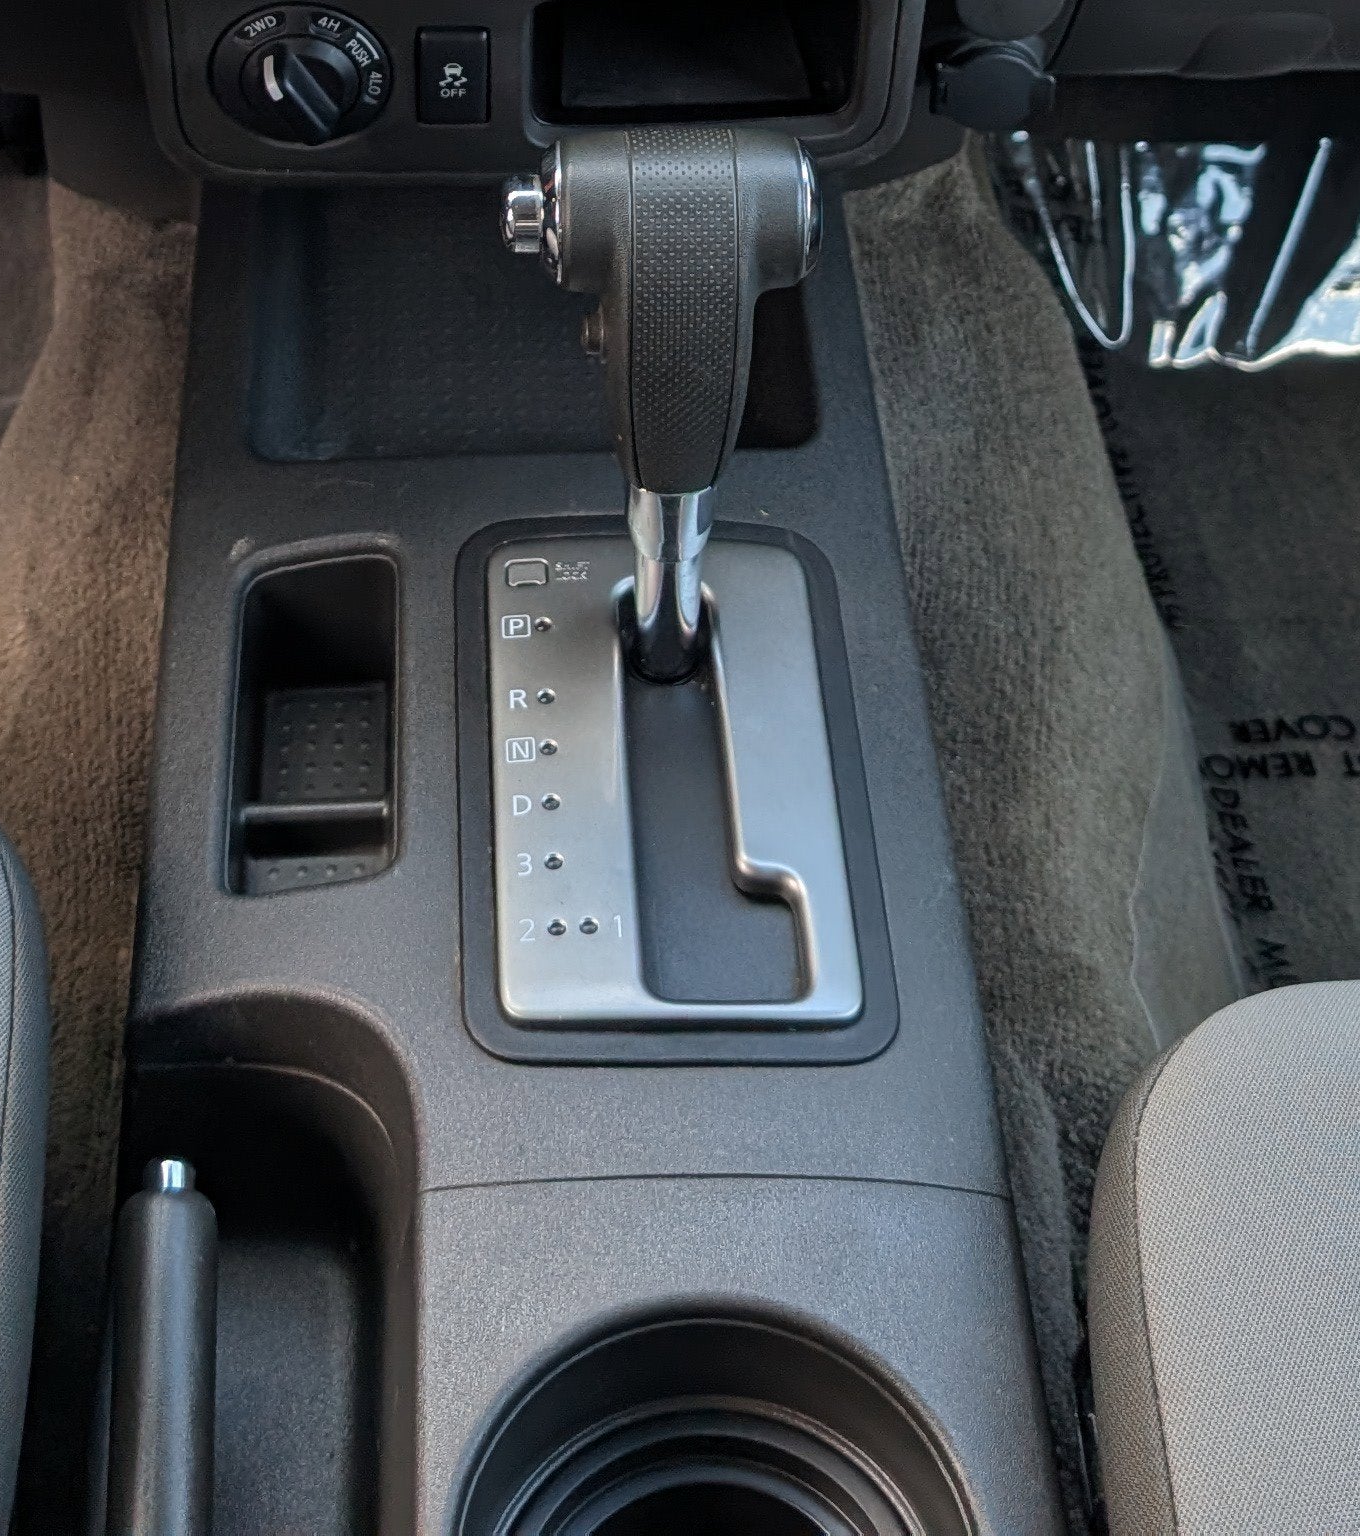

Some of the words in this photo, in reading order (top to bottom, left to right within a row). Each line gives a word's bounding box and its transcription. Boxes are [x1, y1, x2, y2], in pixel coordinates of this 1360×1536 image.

[243, 14, 278, 39] 2WD
[317, 16, 341, 33] 4H
[345, 38, 372, 68] PUSH
[366, 70, 383, 97] 4LO
[440, 88, 467, 99] OFF
[508, 618, 525, 635] P
[509, 689, 528, 709] R
[1228, 713, 1357, 745] COVER
[511, 740, 531, 759] N
[512, 795, 533, 816] D
[516, 853, 533, 876] 3
[519, 919, 536, 942] 2
[613, 914, 623, 938] 1
